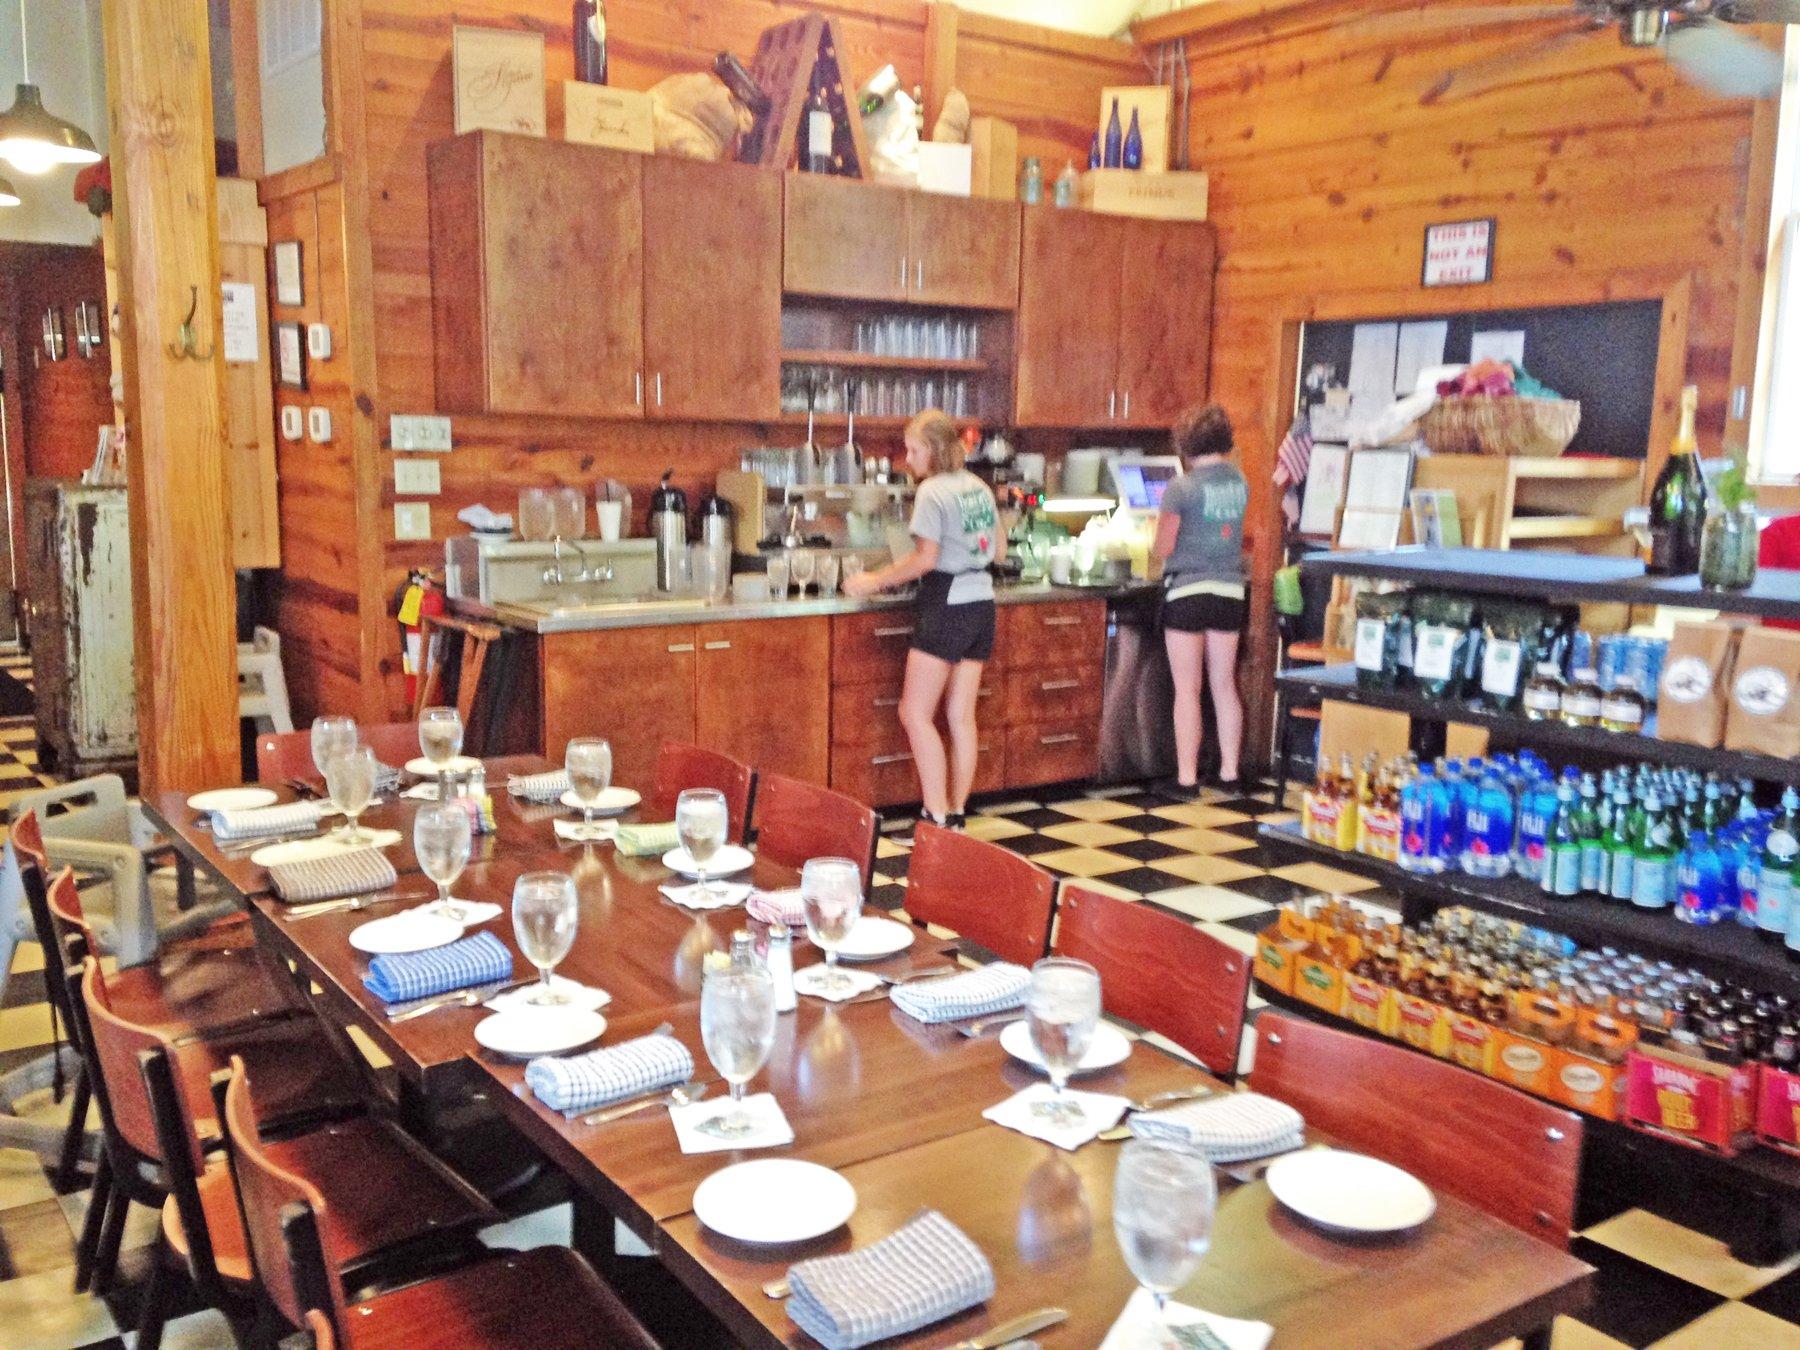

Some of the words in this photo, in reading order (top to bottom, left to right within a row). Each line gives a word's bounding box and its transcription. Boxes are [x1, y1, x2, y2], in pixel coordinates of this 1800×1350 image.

[1433, 226, 1467, 240] THIS
[1473, 223, 1488, 236] IS
[1430, 248, 1458, 261] NOT
[1466, 246, 1488, 258] AN
[1440, 266, 1472, 281] EXIT
